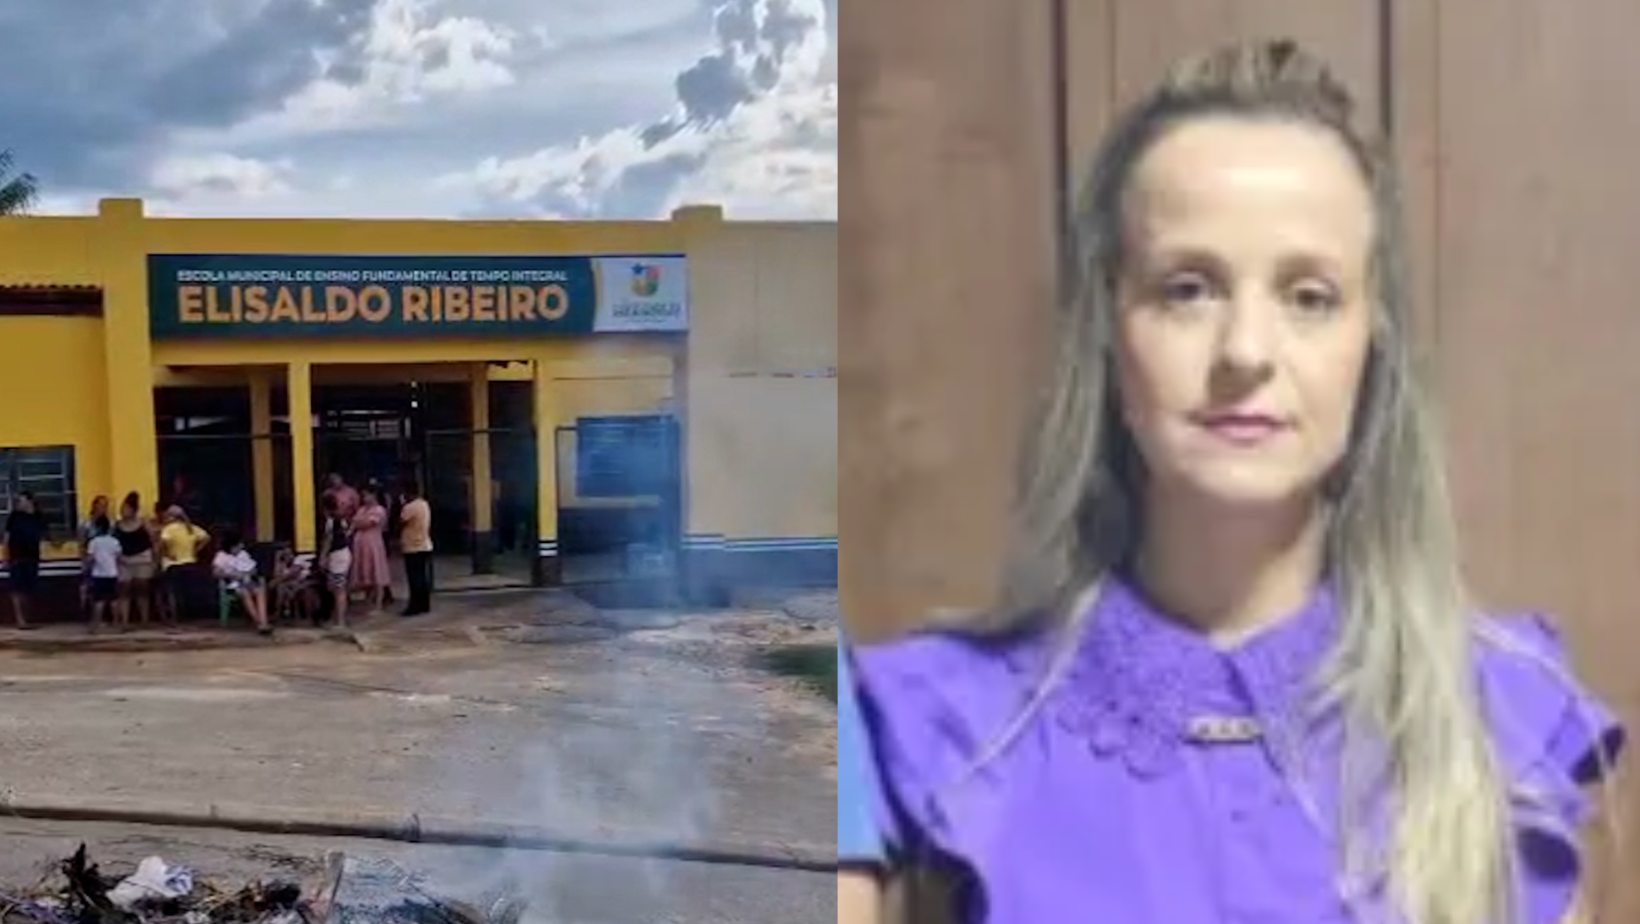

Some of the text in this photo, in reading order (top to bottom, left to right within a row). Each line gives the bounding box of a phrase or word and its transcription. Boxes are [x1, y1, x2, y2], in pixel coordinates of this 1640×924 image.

[177, 270, 567, 281] ESCOLA MUNICIPAL DE ENSINO FUNDAMENTAL DE TEMPO INTEGRAL
[179, 285, 391, 321] ELISALDO
[402, 285, 569, 321] RIBEIRO
